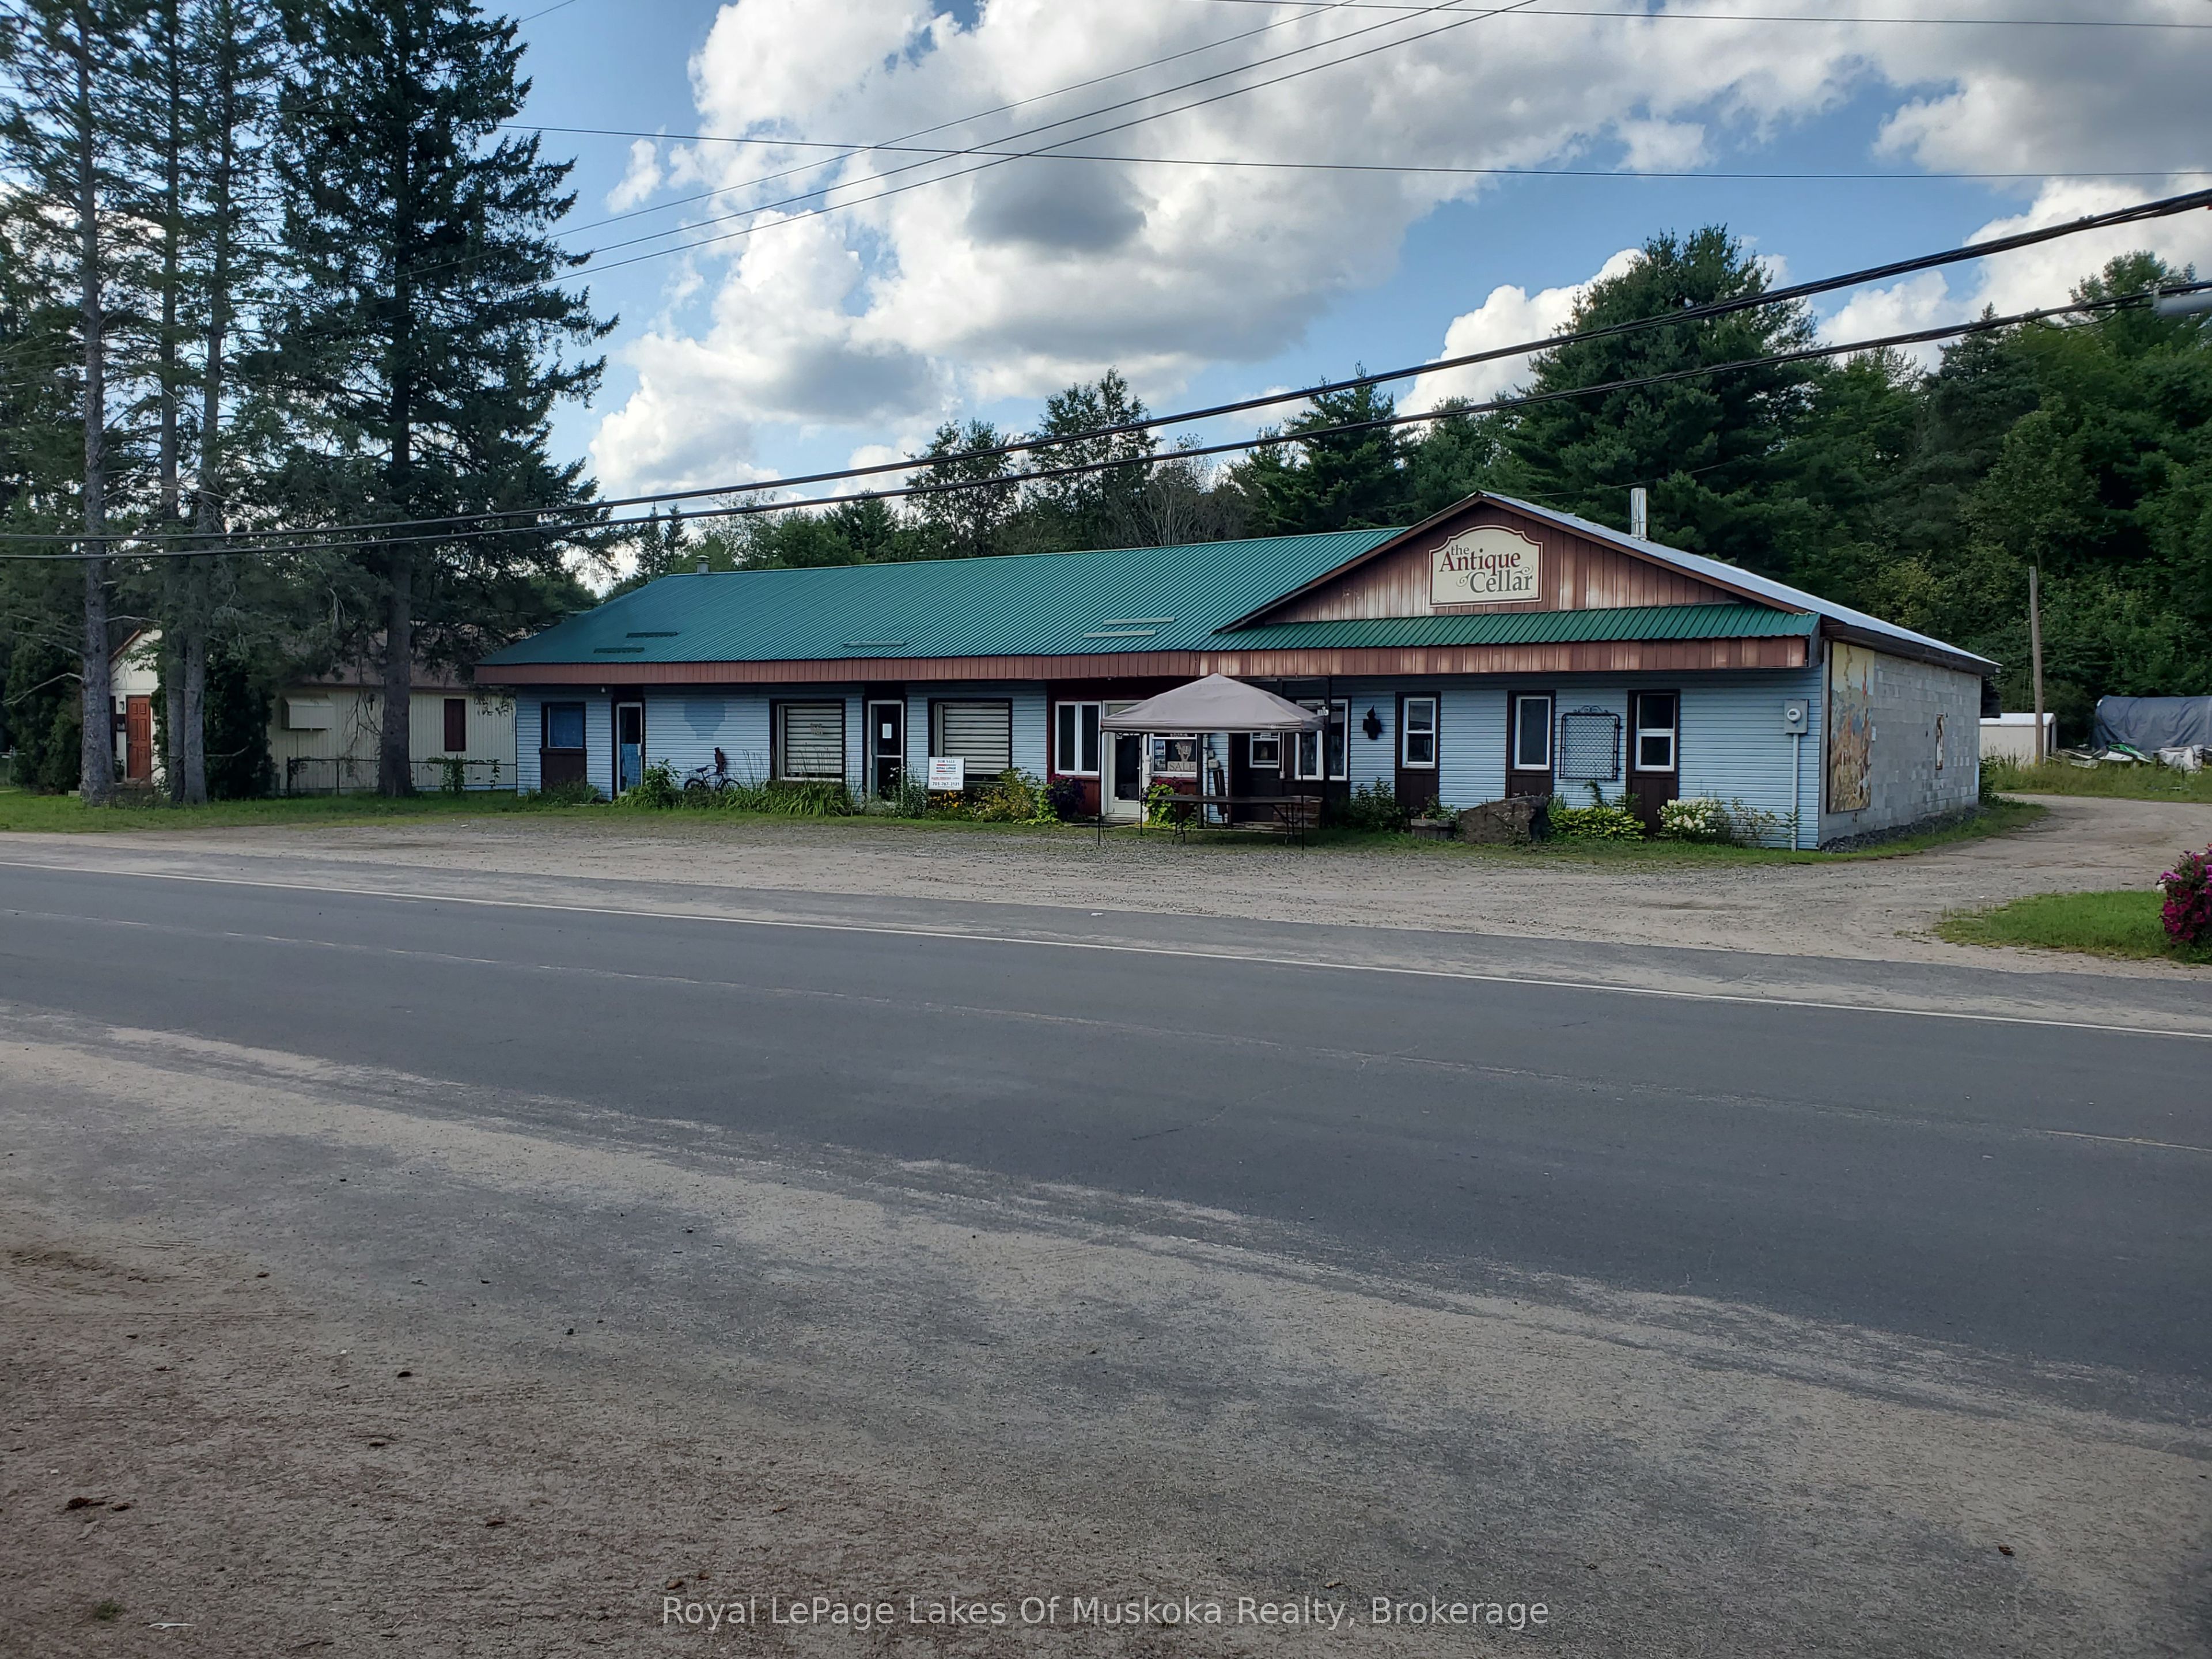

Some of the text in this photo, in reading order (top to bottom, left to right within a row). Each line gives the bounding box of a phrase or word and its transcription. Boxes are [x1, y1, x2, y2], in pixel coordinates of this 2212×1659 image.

[1451, 544, 1469, 555] the
[1439, 548, 1521, 576] Antique
[1469, 569, 1533, 593] Cellar
[1169, 762, 1195, 771] SALE
